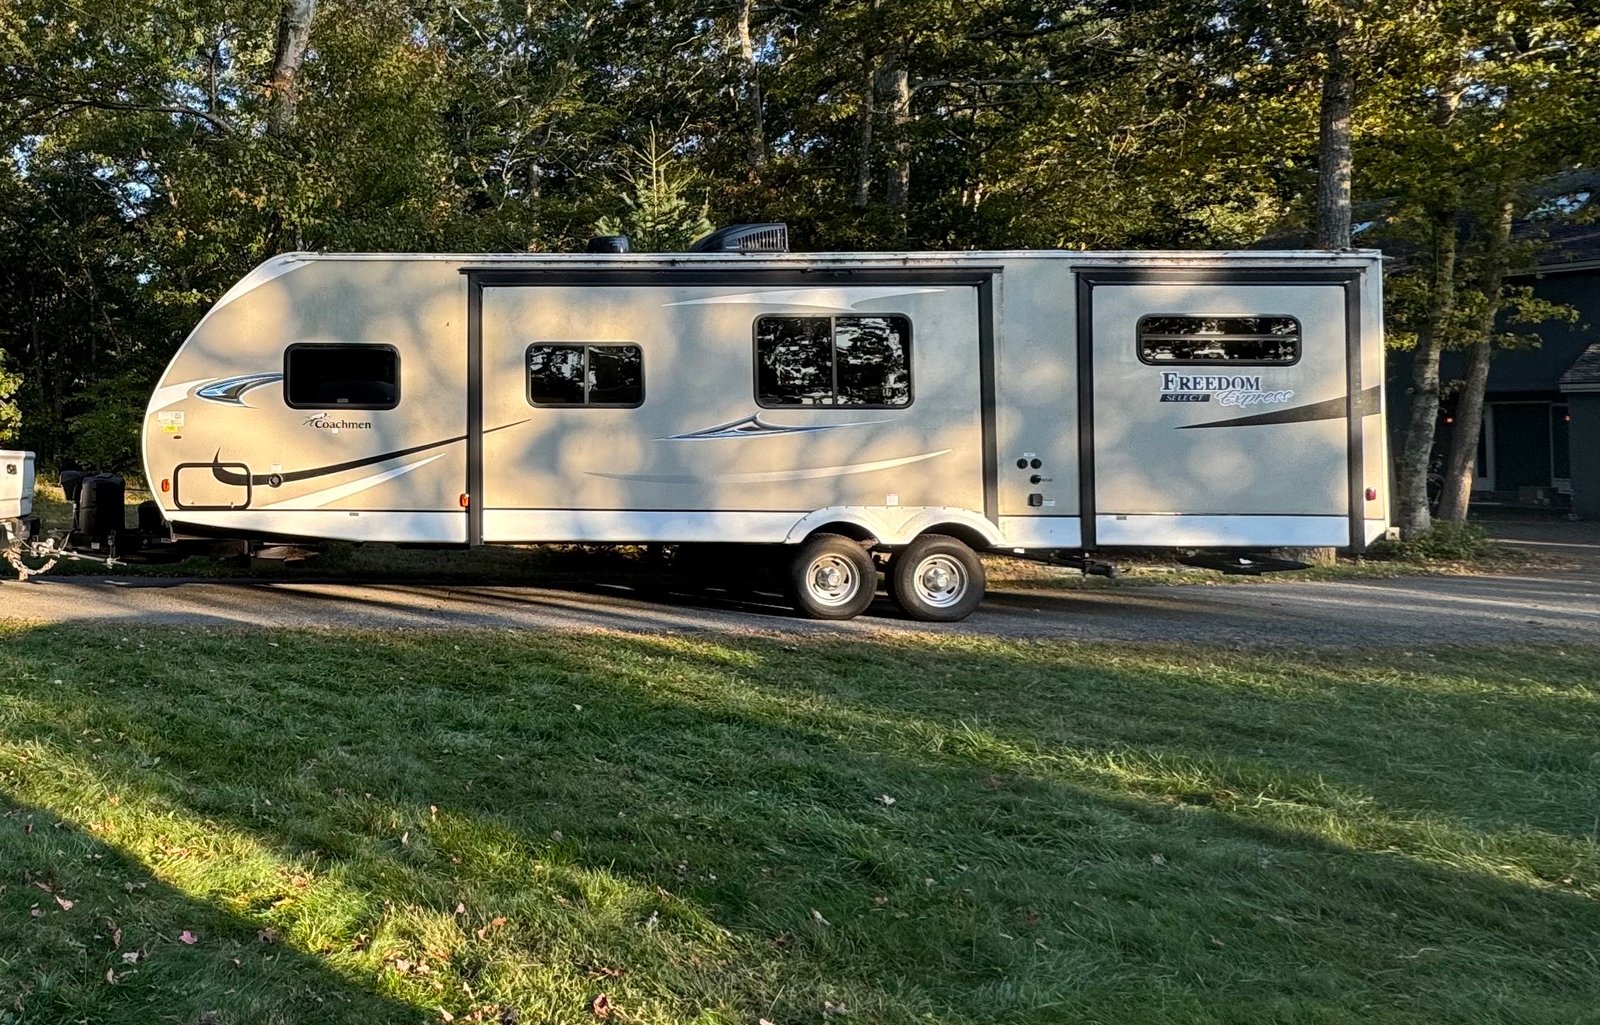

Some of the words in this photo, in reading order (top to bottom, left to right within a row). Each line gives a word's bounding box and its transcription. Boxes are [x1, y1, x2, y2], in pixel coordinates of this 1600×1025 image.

[1161, 372, 1261, 391] FREEDOM
[1215, 389, 1293, 407] Express
[314, 419, 372, 430] Coachmen
